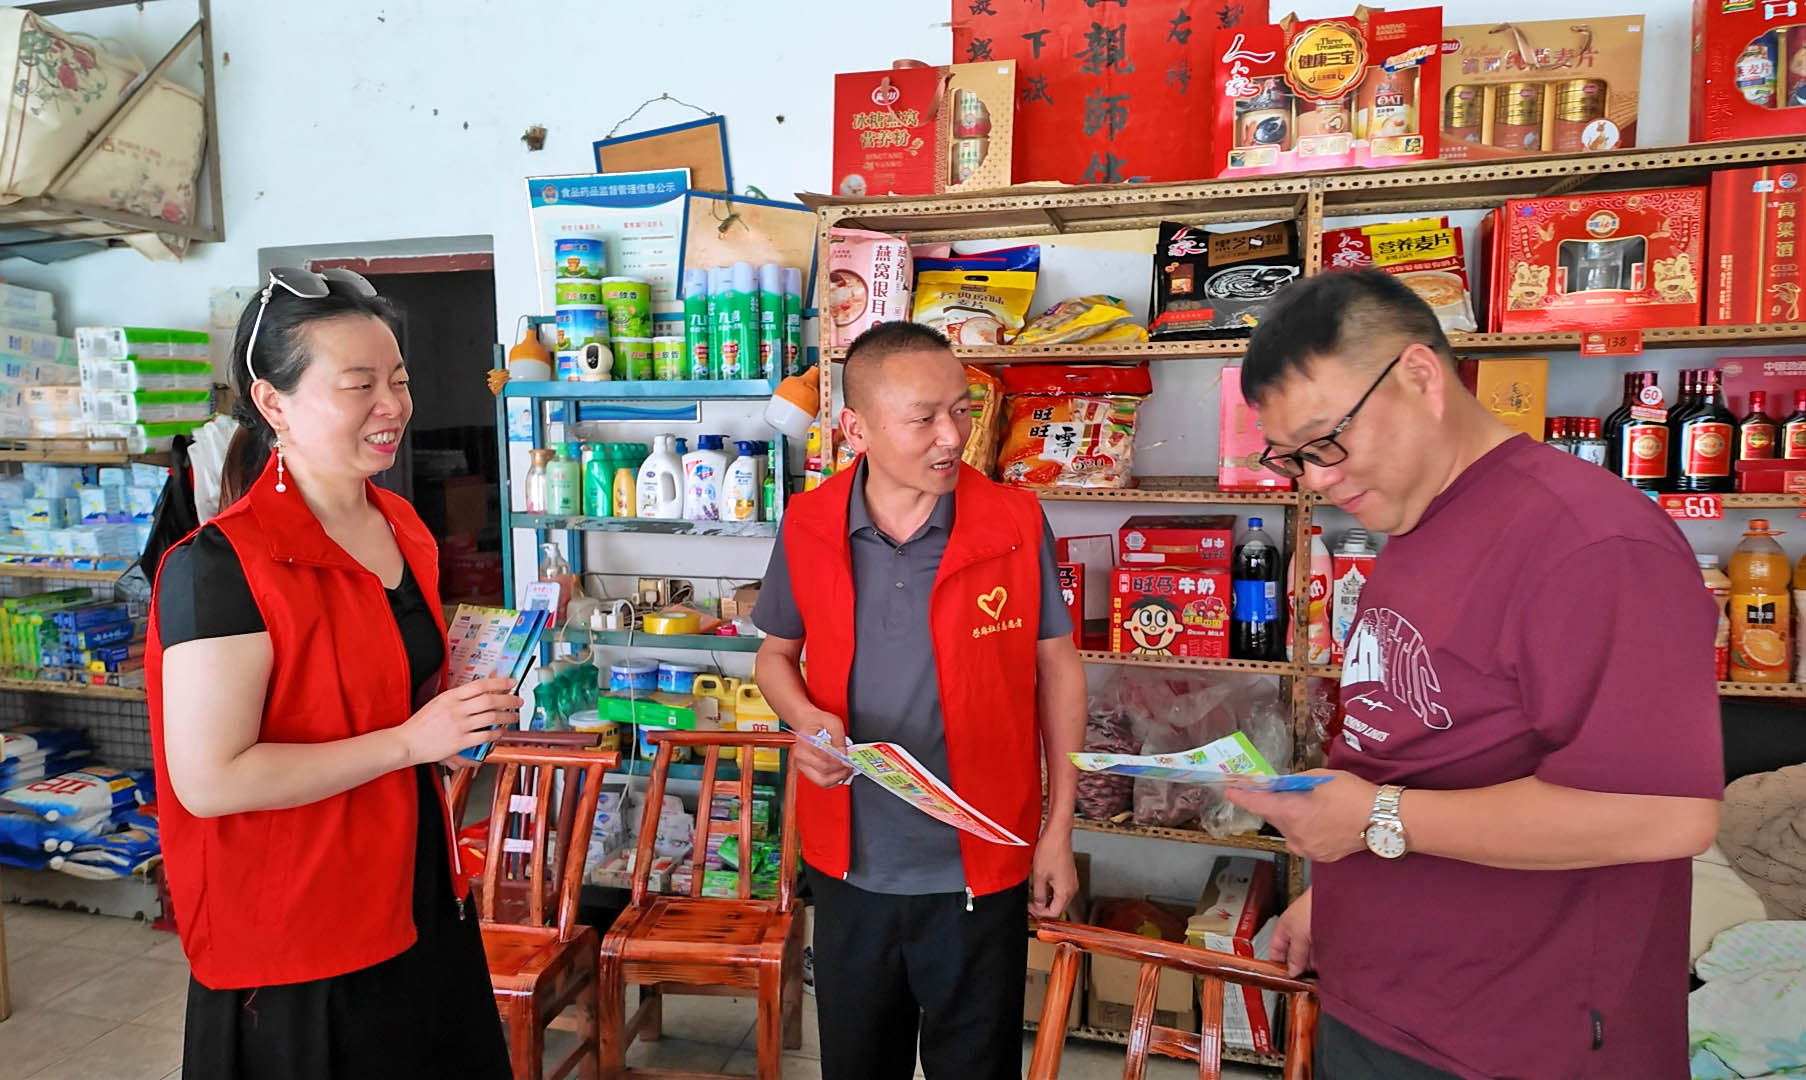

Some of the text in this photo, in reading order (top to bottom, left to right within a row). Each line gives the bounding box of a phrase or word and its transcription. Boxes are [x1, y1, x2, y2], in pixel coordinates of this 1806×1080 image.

[1316, 42, 1353, 51] Treasures
[1320, 37, 1344, 45] Three
[1298, 50, 1355, 69] 健康三宝
[1376, 95, 1403, 106] OAT
[860, 129, 911, 149] 营养粉
[1776, 201, 1796, 258] 高粱酒
[1377, 233, 1451, 254] 营养麦片
[871, 244, 891, 317] 燕窝银耳
[1643, 389, 1659, 401] 60
[1029, 407, 1054, 438] 旺旺
[1685, 497, 1716, 518] 60
